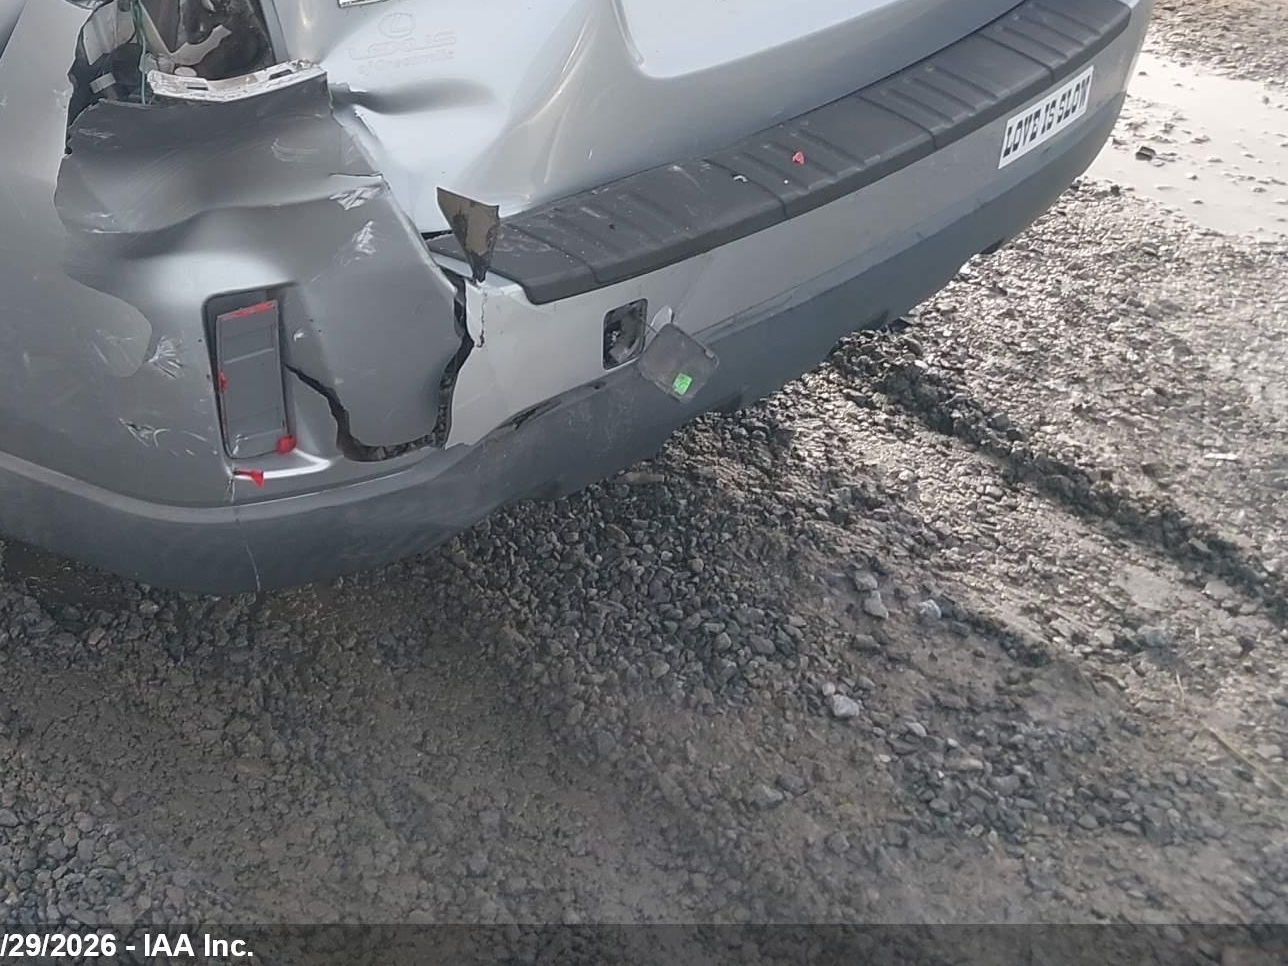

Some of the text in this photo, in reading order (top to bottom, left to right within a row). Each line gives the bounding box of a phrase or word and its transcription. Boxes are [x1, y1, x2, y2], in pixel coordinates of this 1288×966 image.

[1002, 75, 1090, 158] LOVE IS SLOW
